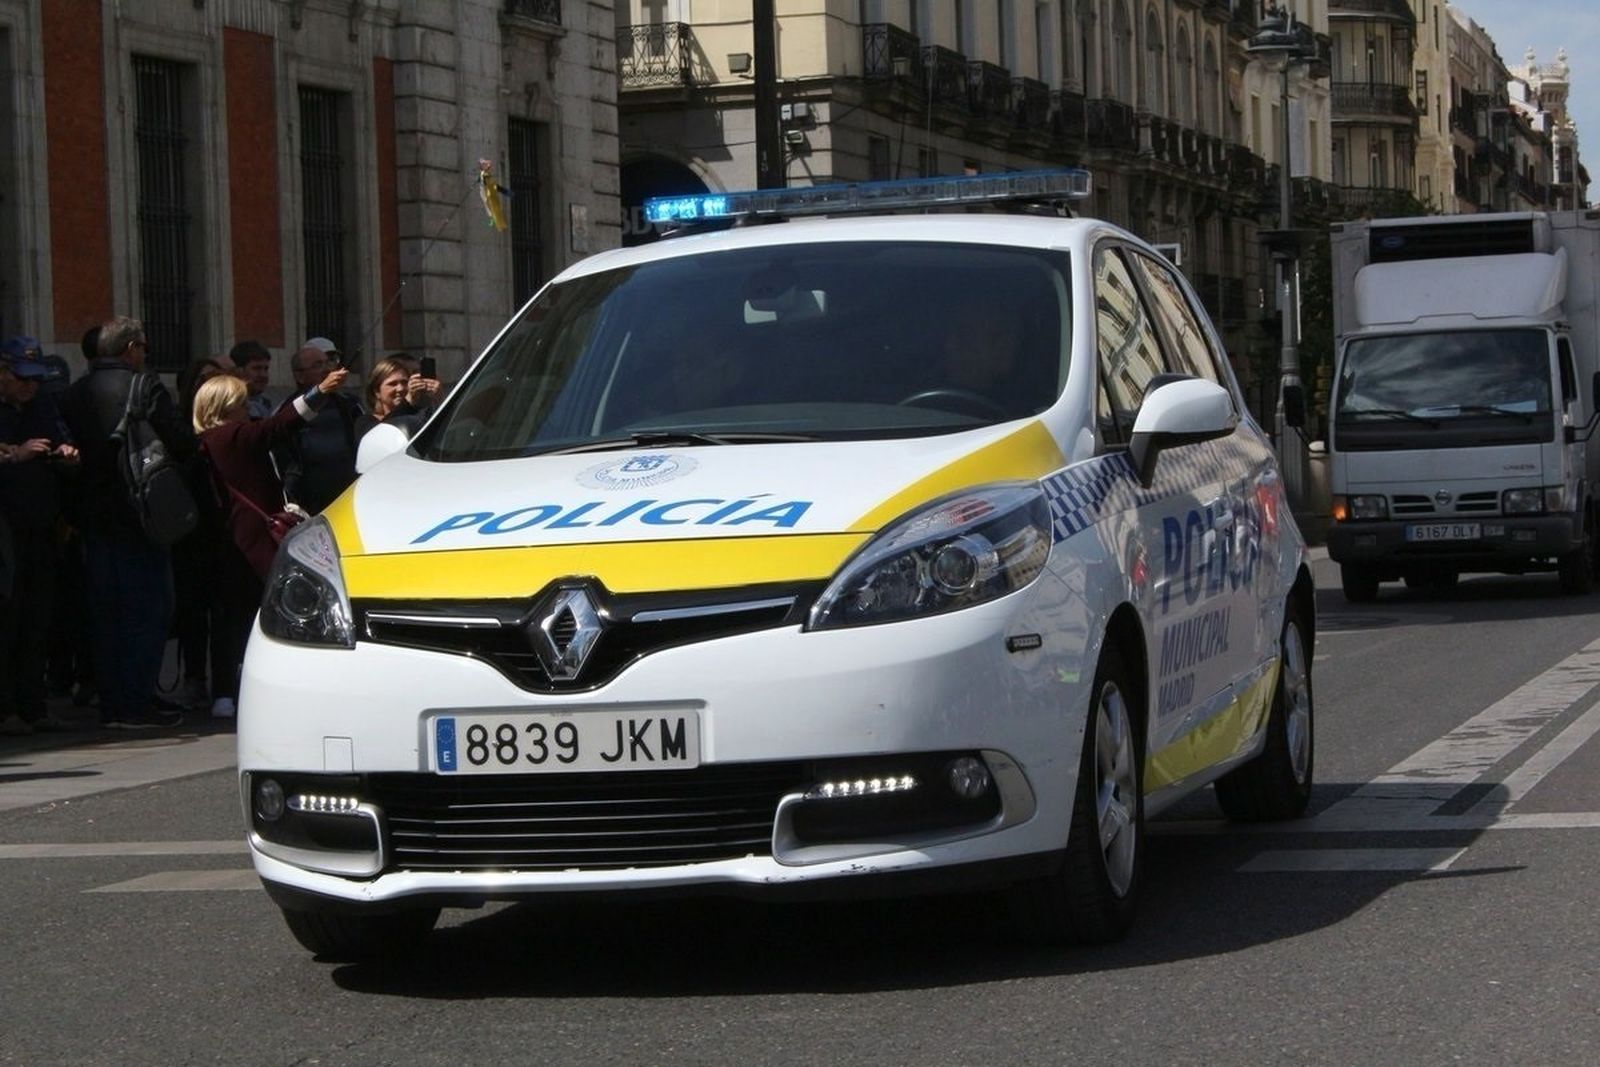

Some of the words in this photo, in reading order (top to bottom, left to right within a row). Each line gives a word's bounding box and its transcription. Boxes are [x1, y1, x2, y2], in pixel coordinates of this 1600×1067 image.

[409, 493, 813, 544] POLICÍA
[1416, 526, 1448, 538] 6167
[1159, 608, 1230, 677] MUNICIPAL
[1158, 672, 1194, 716] MADRID
[443, 751, 451, 763] E
[466, 722, 580, 766] 8839
[600, 718, 687, 762] JKM
